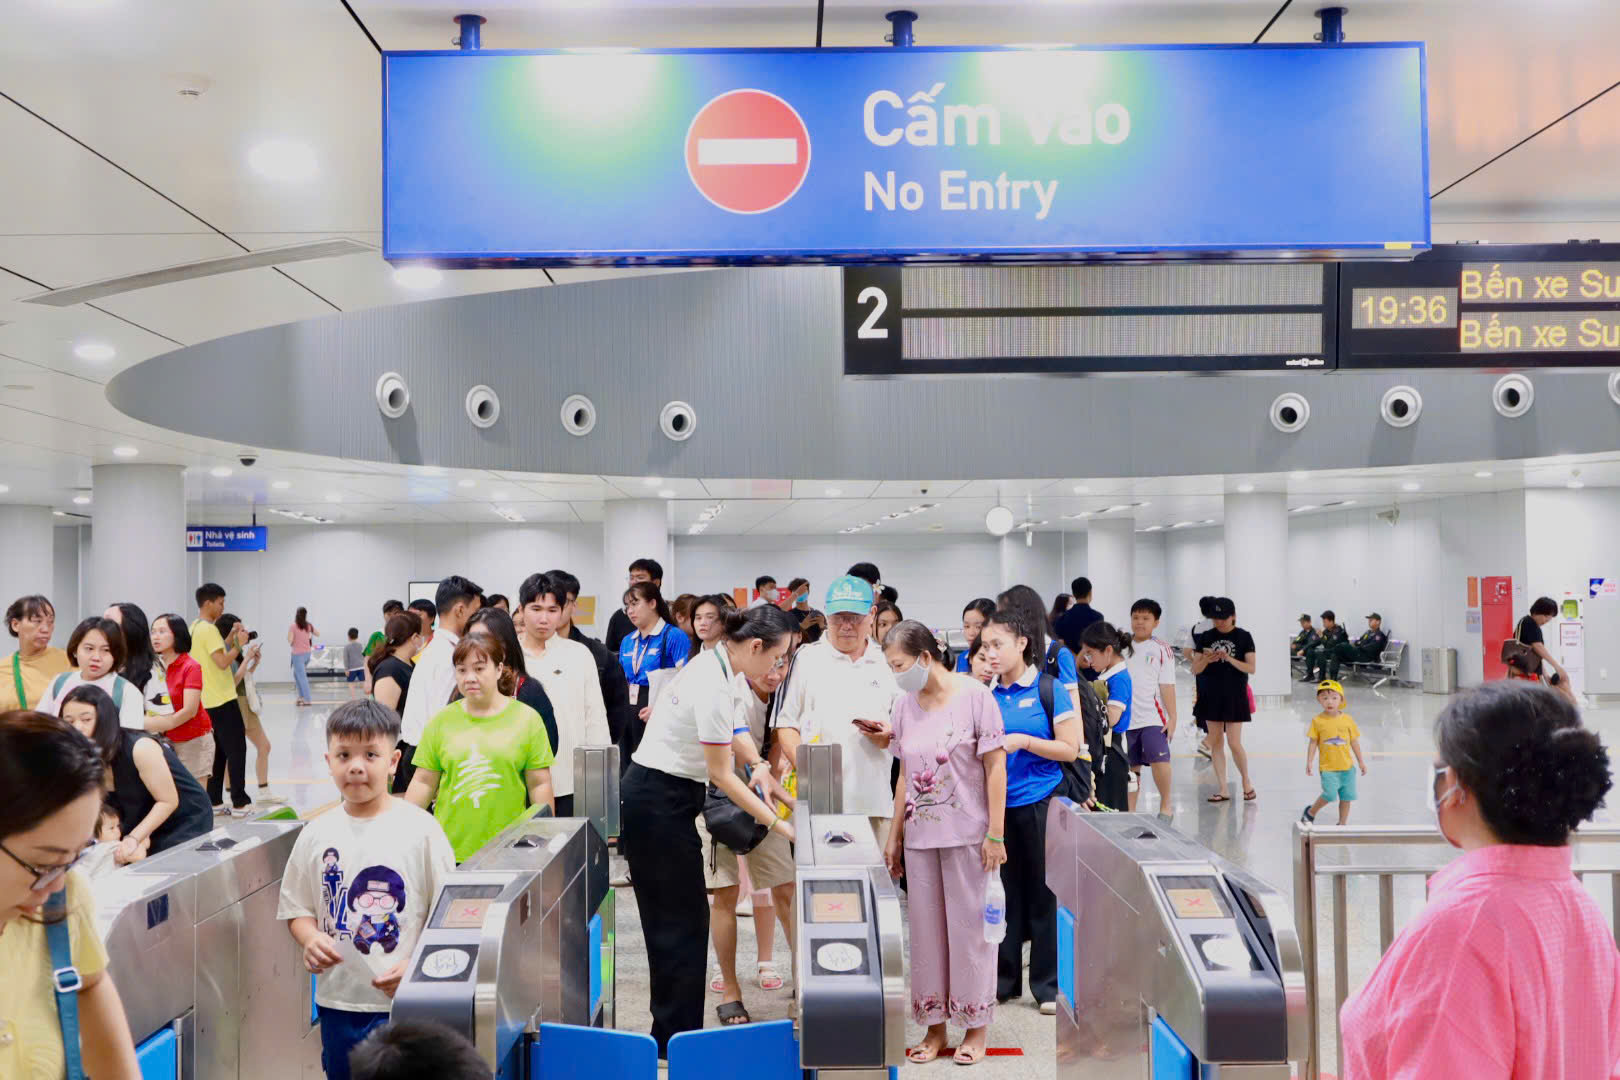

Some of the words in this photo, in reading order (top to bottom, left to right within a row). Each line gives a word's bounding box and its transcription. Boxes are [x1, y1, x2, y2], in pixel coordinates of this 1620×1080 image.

[863, 82, 1000, 146] Cấm
[864, 171, 924, 211] No
[940, 170, 1058, 220] Entry
[1461, 264, 1523, 299] Bến
[1534, 276, 1568, 299] xe
[1580, 269, 1620, 299] Su
[857, 286, 888, 339] 2
[1361, 295, 1448, 325] 19:36
[1460, 313, 1522, 349] Bến
[1532, 325, 1567, 348] xe
[1578, 318, 1620, 348] Su
[236, 531, 255, 539] sinh
